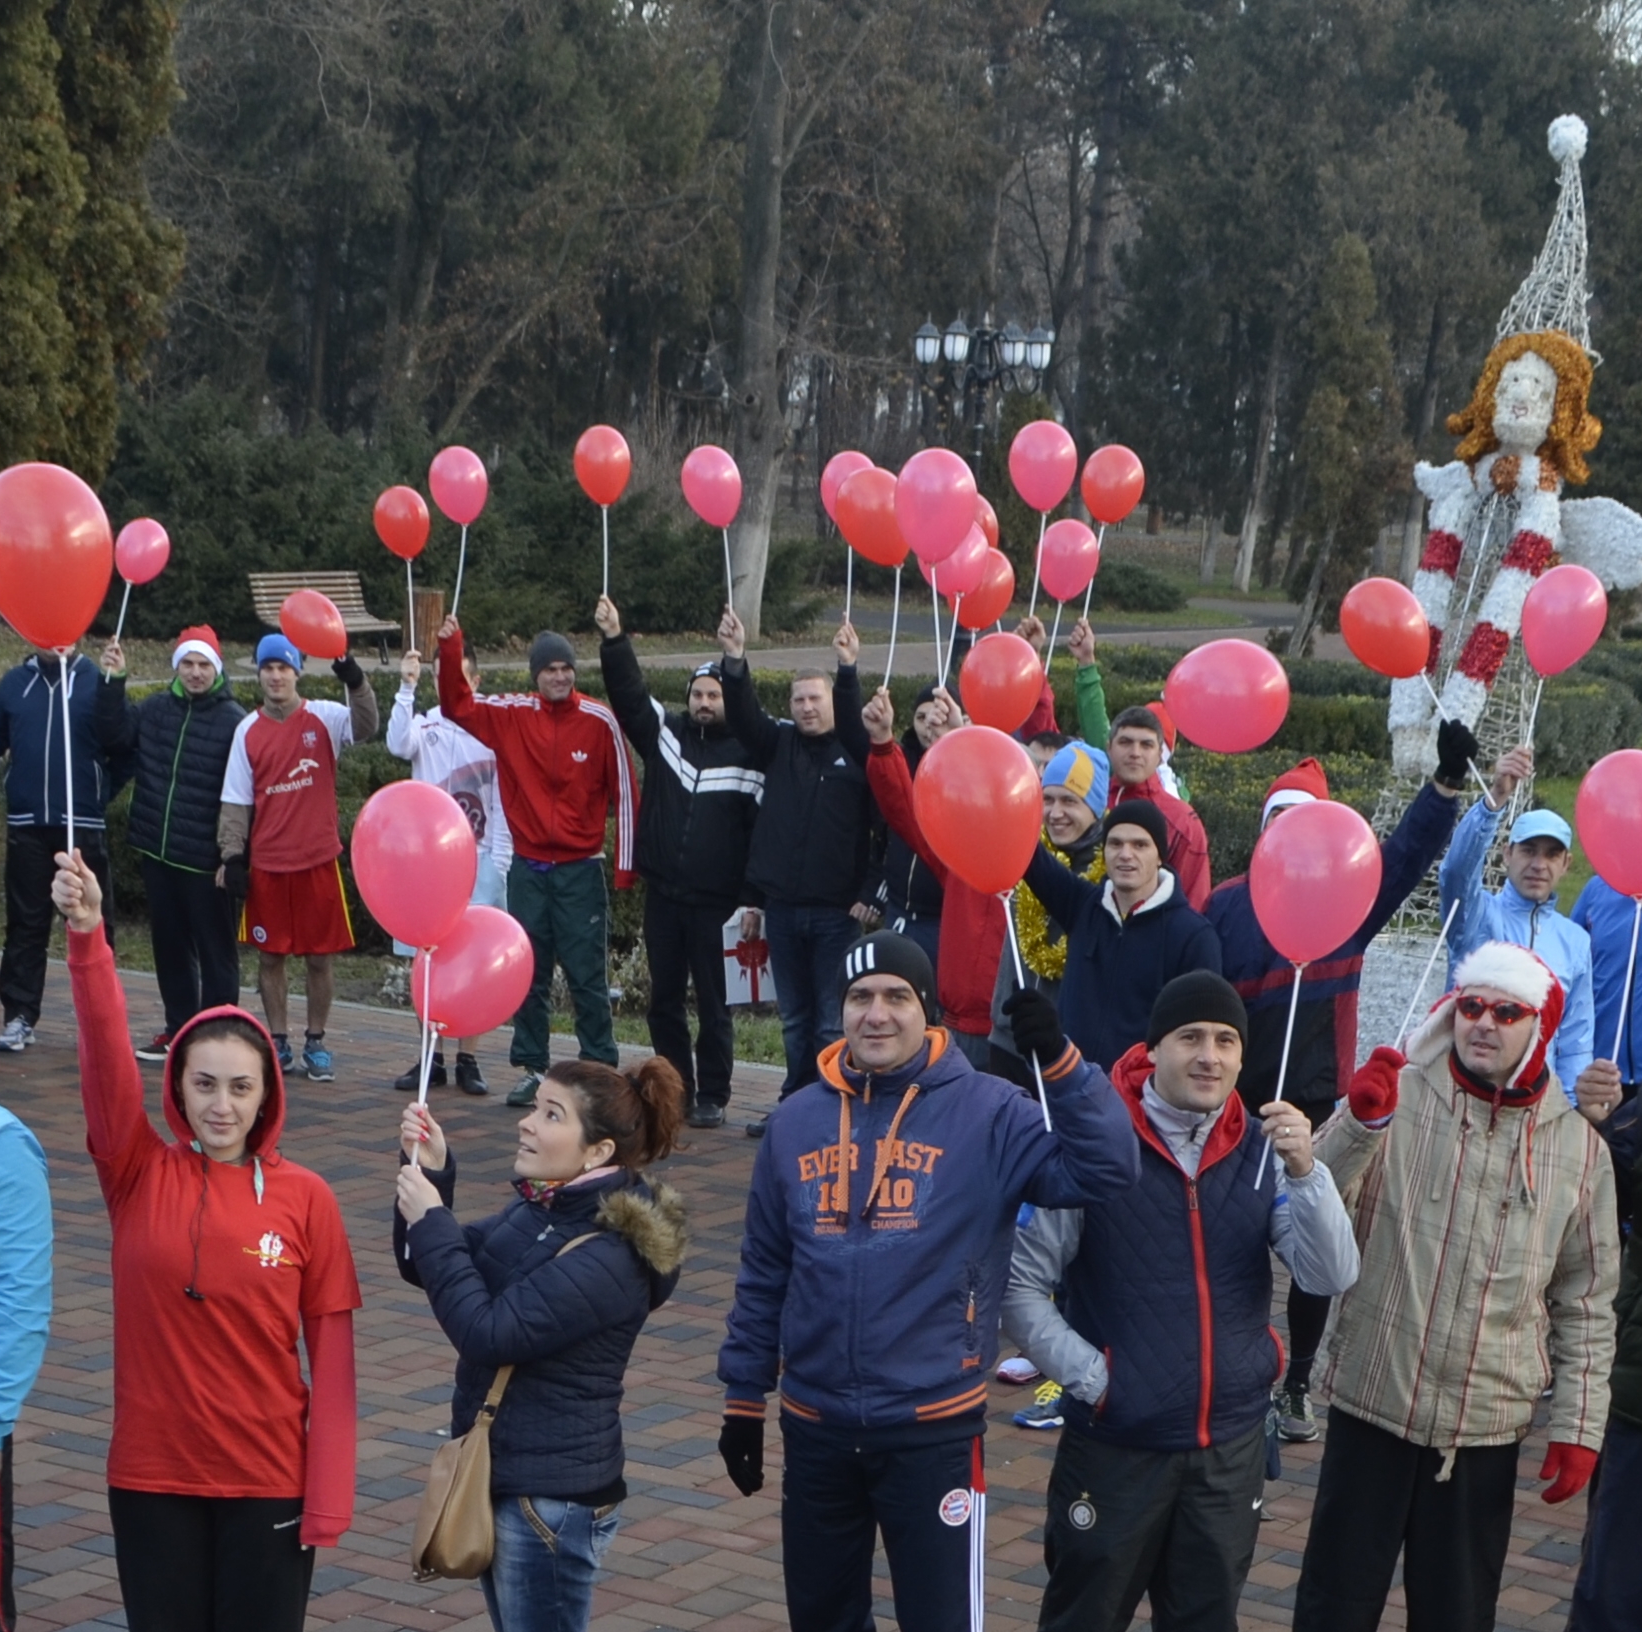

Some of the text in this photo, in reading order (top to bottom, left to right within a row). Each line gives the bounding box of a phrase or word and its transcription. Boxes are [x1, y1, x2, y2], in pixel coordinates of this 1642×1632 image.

[798, 1142, 860, 1182] EVER
[876, 1176, 915, 1208] 10
[871, 1219, 918, 1231] CHAMPION
